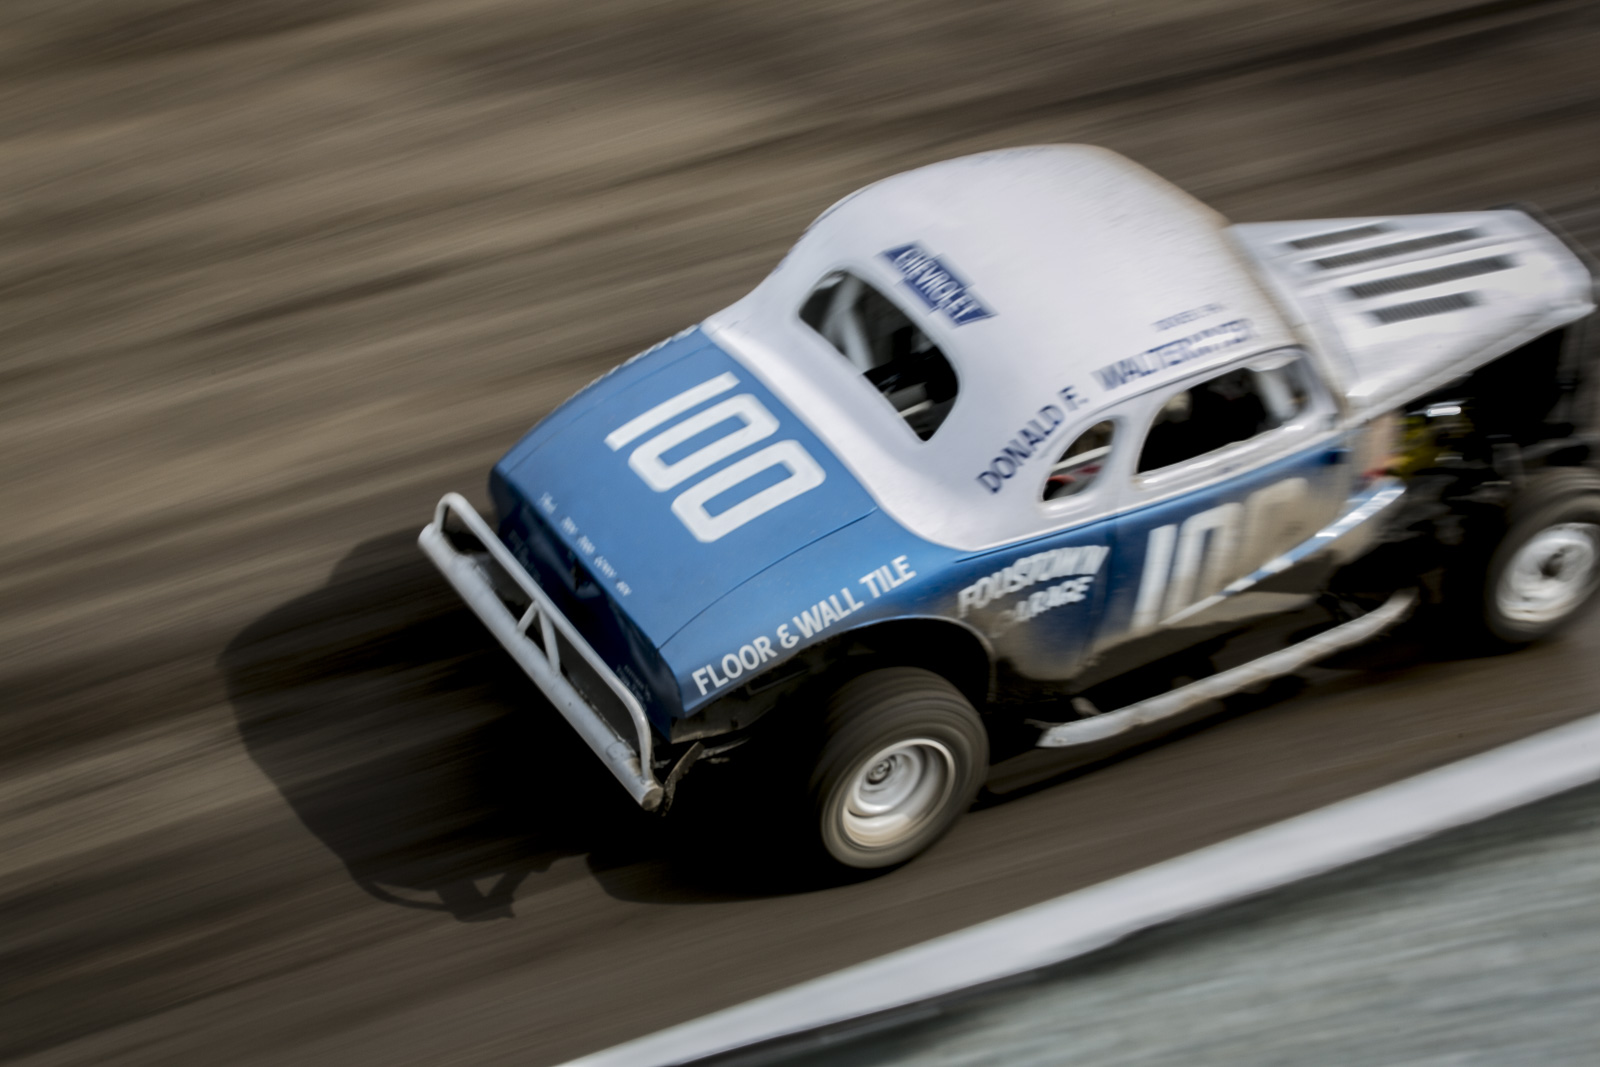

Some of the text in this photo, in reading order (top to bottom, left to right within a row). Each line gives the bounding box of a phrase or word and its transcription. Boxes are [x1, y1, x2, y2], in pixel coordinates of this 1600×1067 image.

[886, 243, 988, 324] CHEVROLET
[604, 371, 826, 543] 100
[976, 406, 1065, 493] DONALD
[691, 637, 777, 696] FLOOR
[777, 623, 801, 651] &
[793, 587, 865, 639] WALL
[859, 554, 917, 599] TILE
